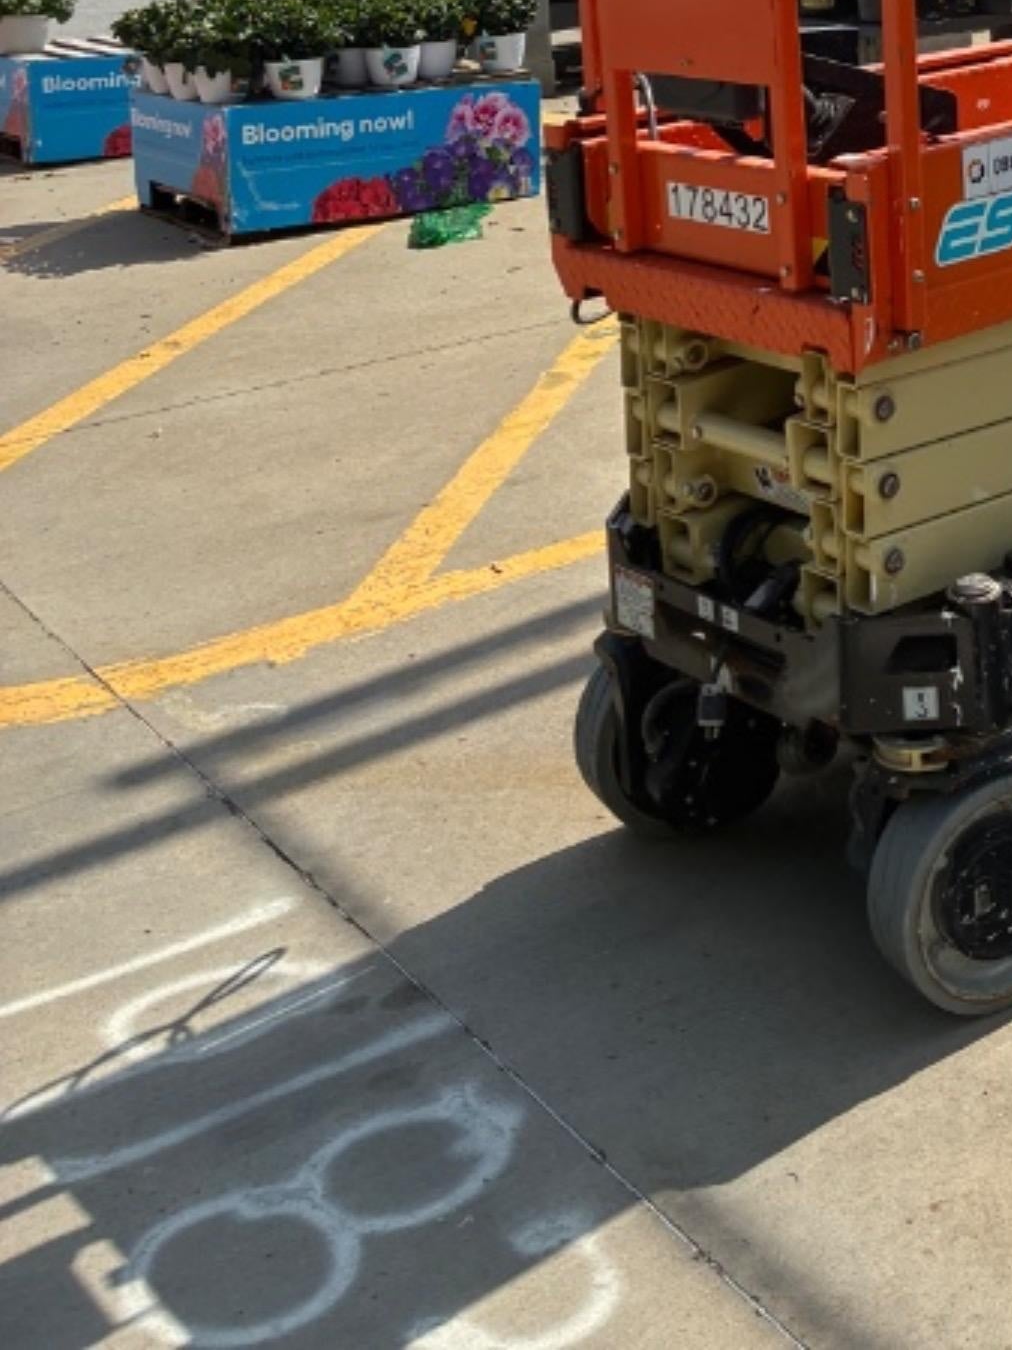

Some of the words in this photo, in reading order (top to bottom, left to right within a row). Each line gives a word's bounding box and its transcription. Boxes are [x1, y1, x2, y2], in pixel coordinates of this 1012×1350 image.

[241, 116, 355, 145] Blooming
[359, 109, 415, 134] now!
[671, 184, 769, 232] 178432
